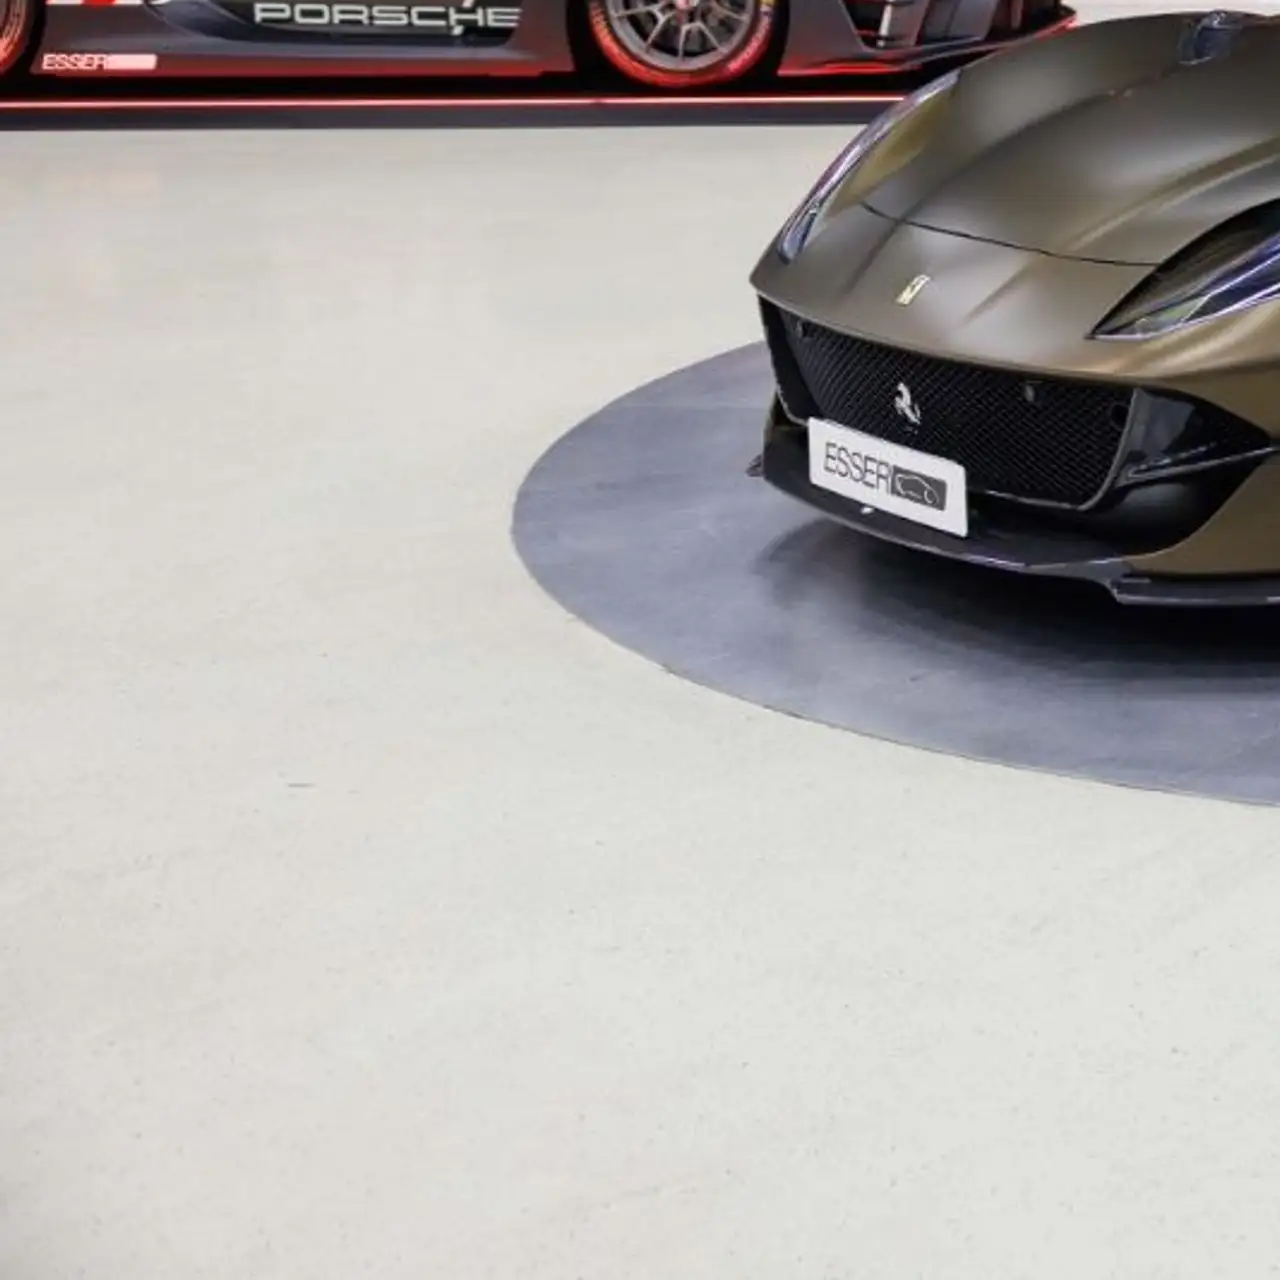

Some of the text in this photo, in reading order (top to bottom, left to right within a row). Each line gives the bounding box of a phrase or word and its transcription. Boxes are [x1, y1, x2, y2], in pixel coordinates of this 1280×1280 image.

[253, 3, 522, 28] PORSCHE
[42, 52, 107, 70] ESSER
[823, 441, 891, 495] ESSER
